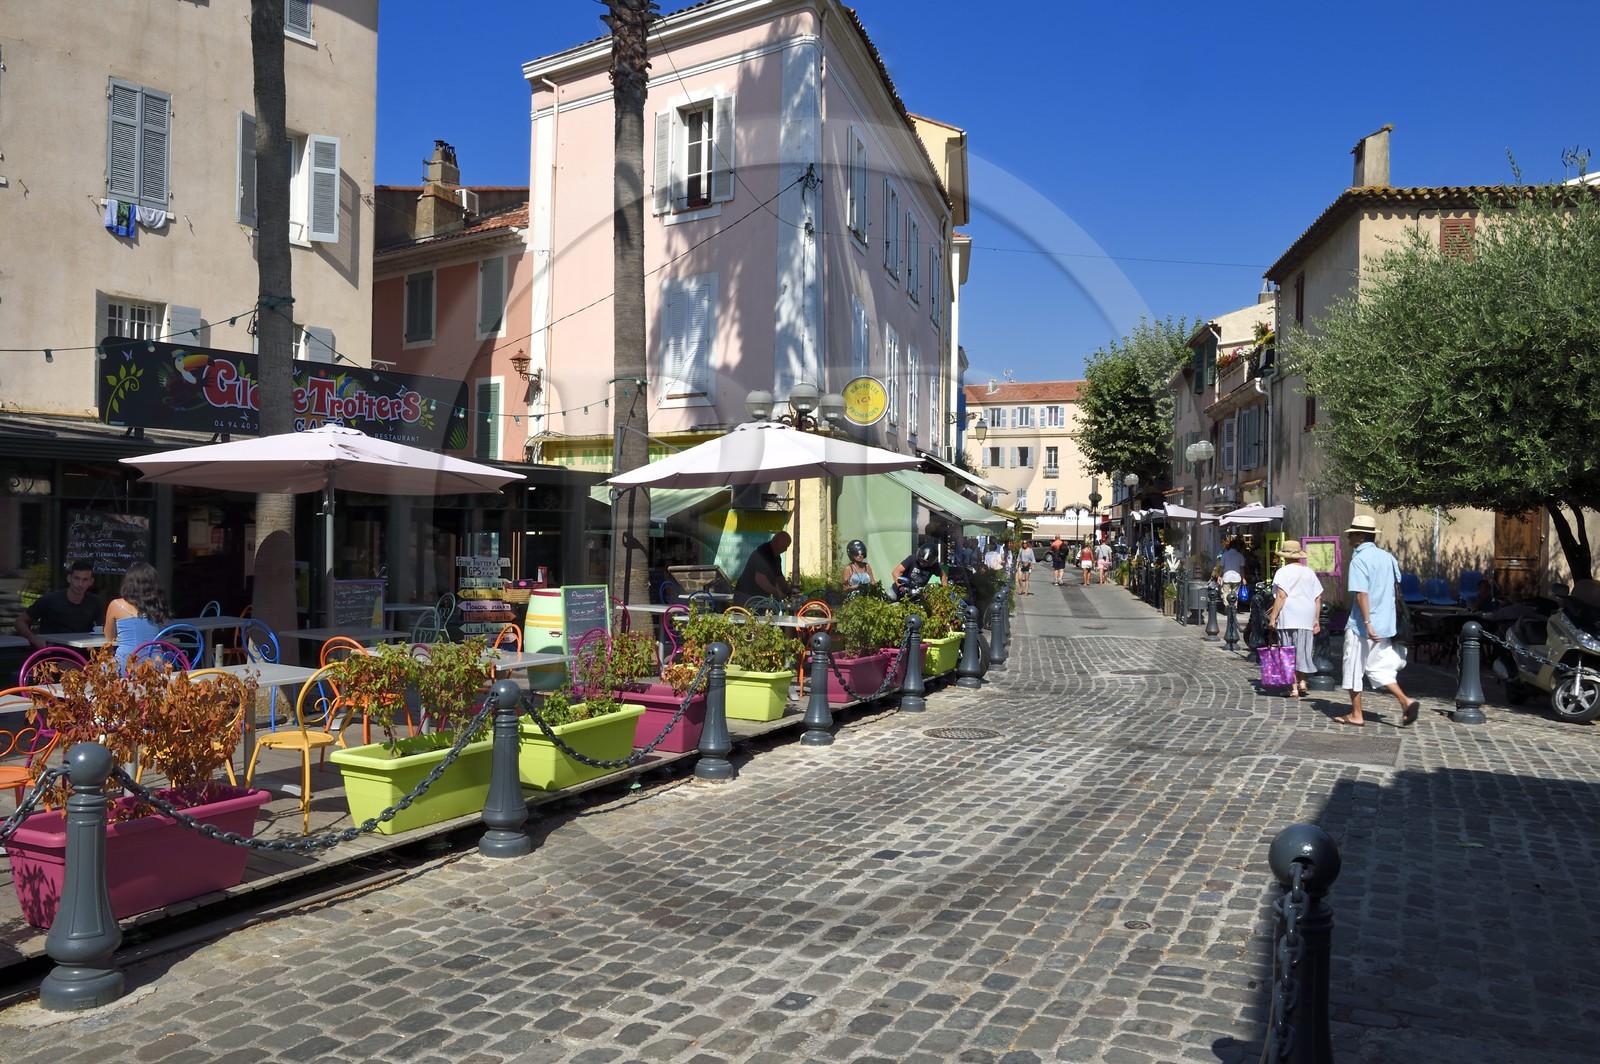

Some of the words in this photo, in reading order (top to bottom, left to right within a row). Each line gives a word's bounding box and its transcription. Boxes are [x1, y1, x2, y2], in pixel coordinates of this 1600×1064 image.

[202, 359, 310, 414] Gloe
[850, 383, 879, 394] RAVIOLIS
[857, 396, 871, 404] ICI
[849, 406, 879, 418] FROMAGES
[374, 432, 420, 442] RESTAURANT
[558, 449, 576, 467] LA
[581, 448, 614, 466] MAIS
[648, 446, 670, 464] DU
[468, 566, 481, 576] GPS
